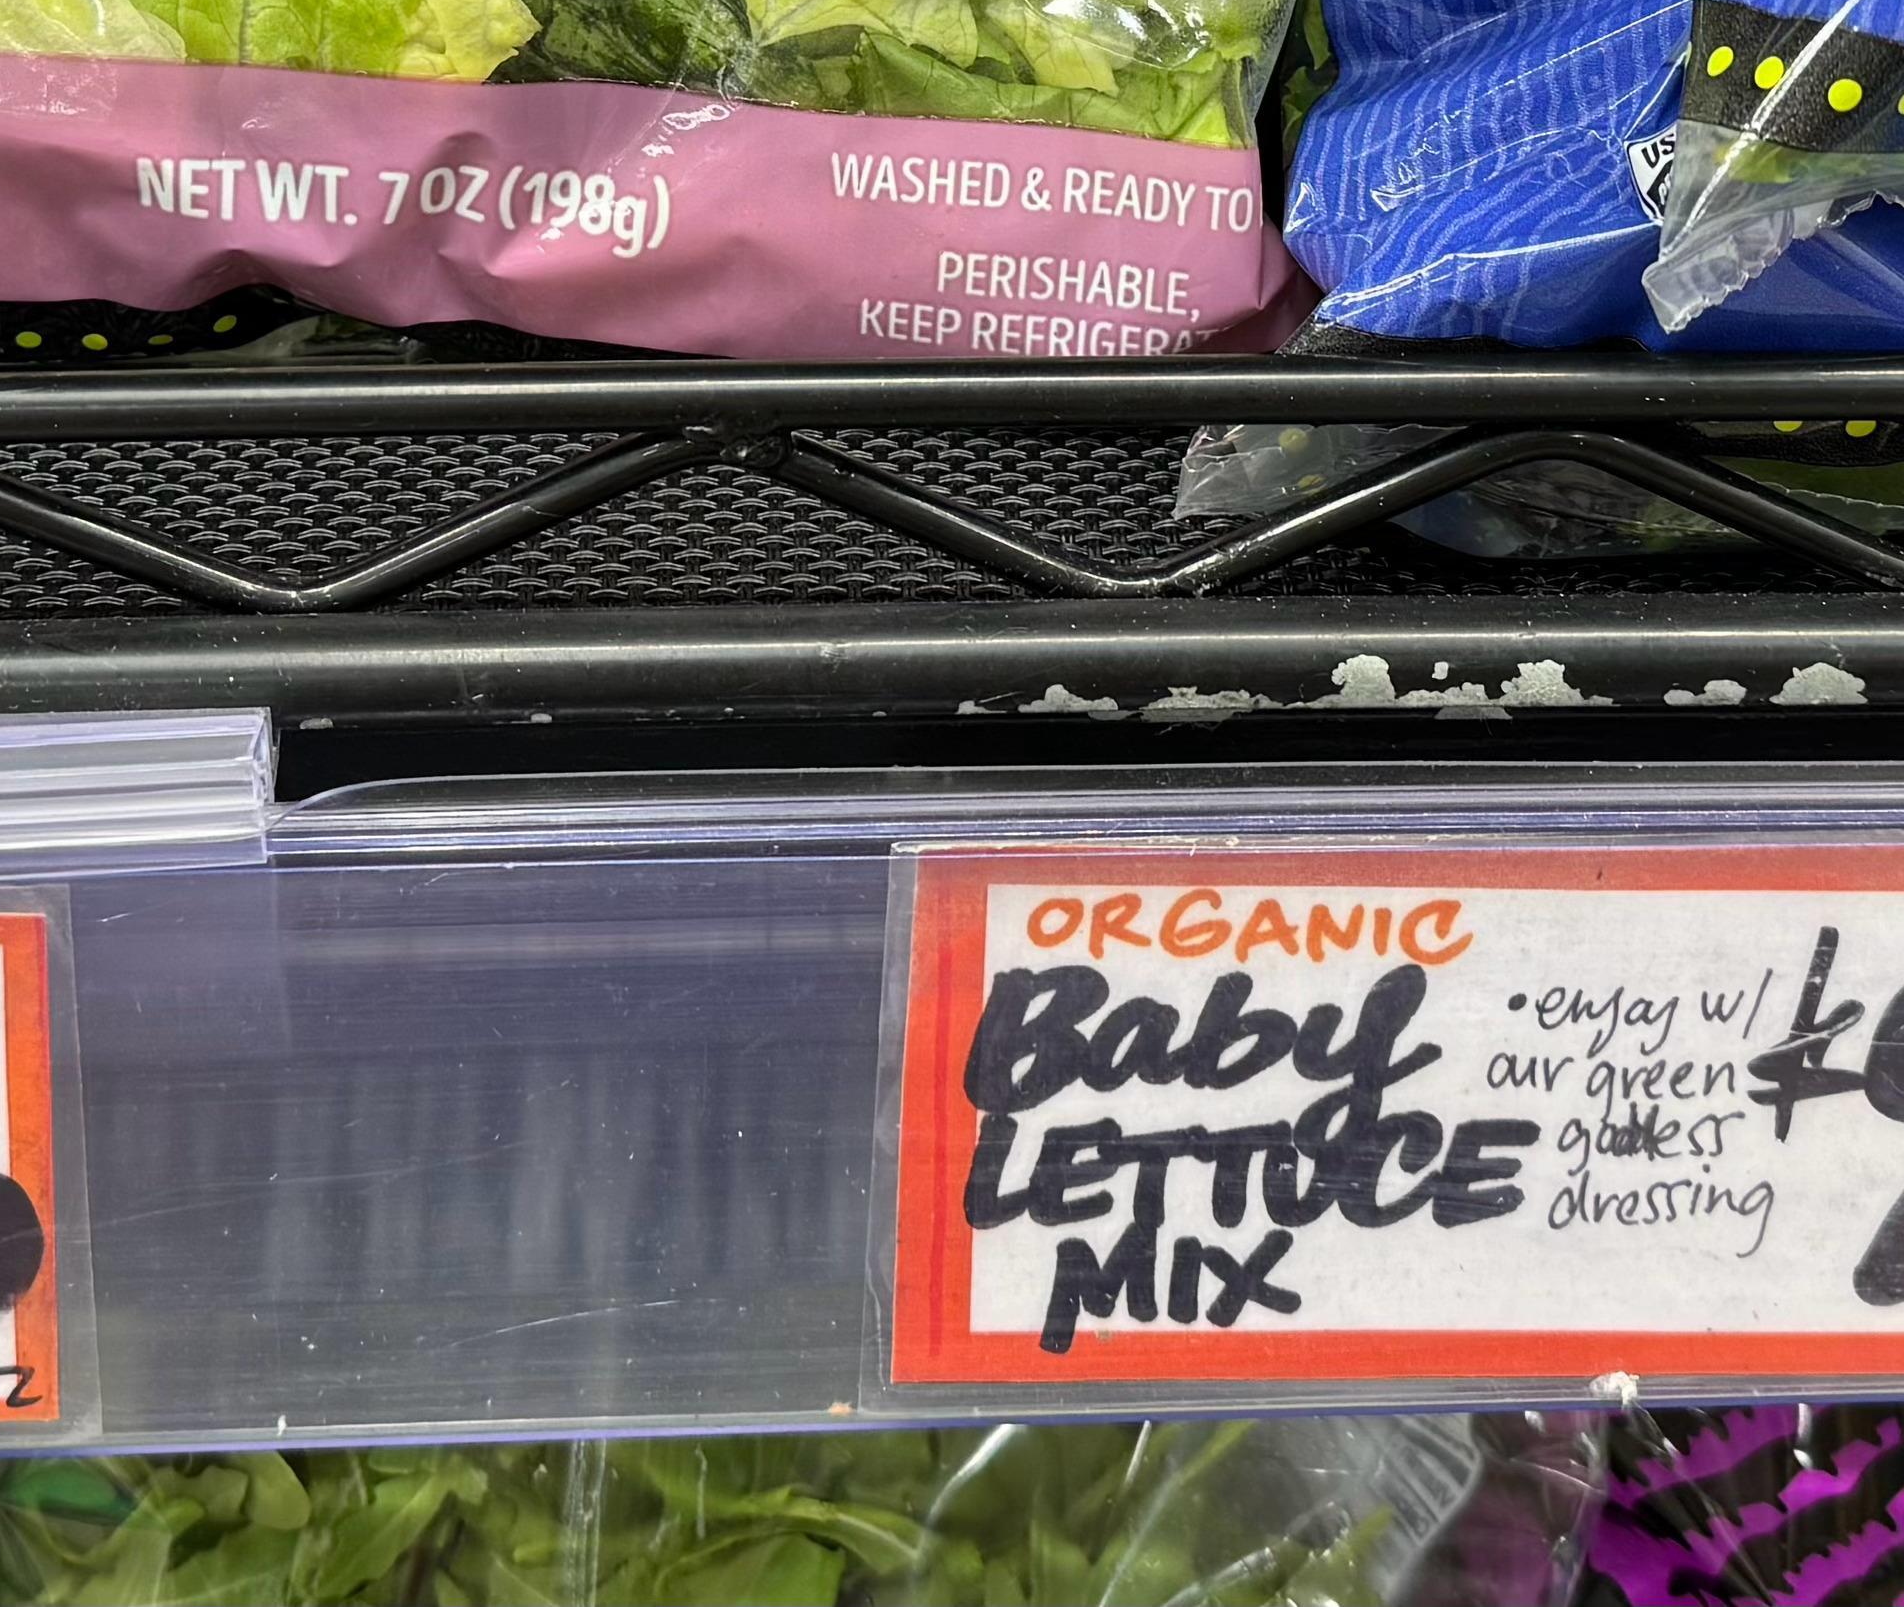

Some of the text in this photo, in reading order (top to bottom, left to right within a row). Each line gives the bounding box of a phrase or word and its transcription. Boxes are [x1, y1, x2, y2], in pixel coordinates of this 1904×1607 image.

[136, 157, 246, 221] NET
[256, 159, 358, 226] WT.
[499, 165, 671, 259] (198g)
[832, 152, 1254, 234] WASHED & READY TO
[860, 298, 962, 346] KEEP
[937, 250, 1201, 322] PERISHABLE,
[1026, 888, 1474, 966] ORGANIC
[963, 963, 1443, 1156] Baby
[1486, 1052, 1738, 1122] our green
[963, 1110, 1542, 1230] LETTUCE
[1548, 1170, 1775, 1258] dressing
[1039, 1224, 1302, 1354] MIX
